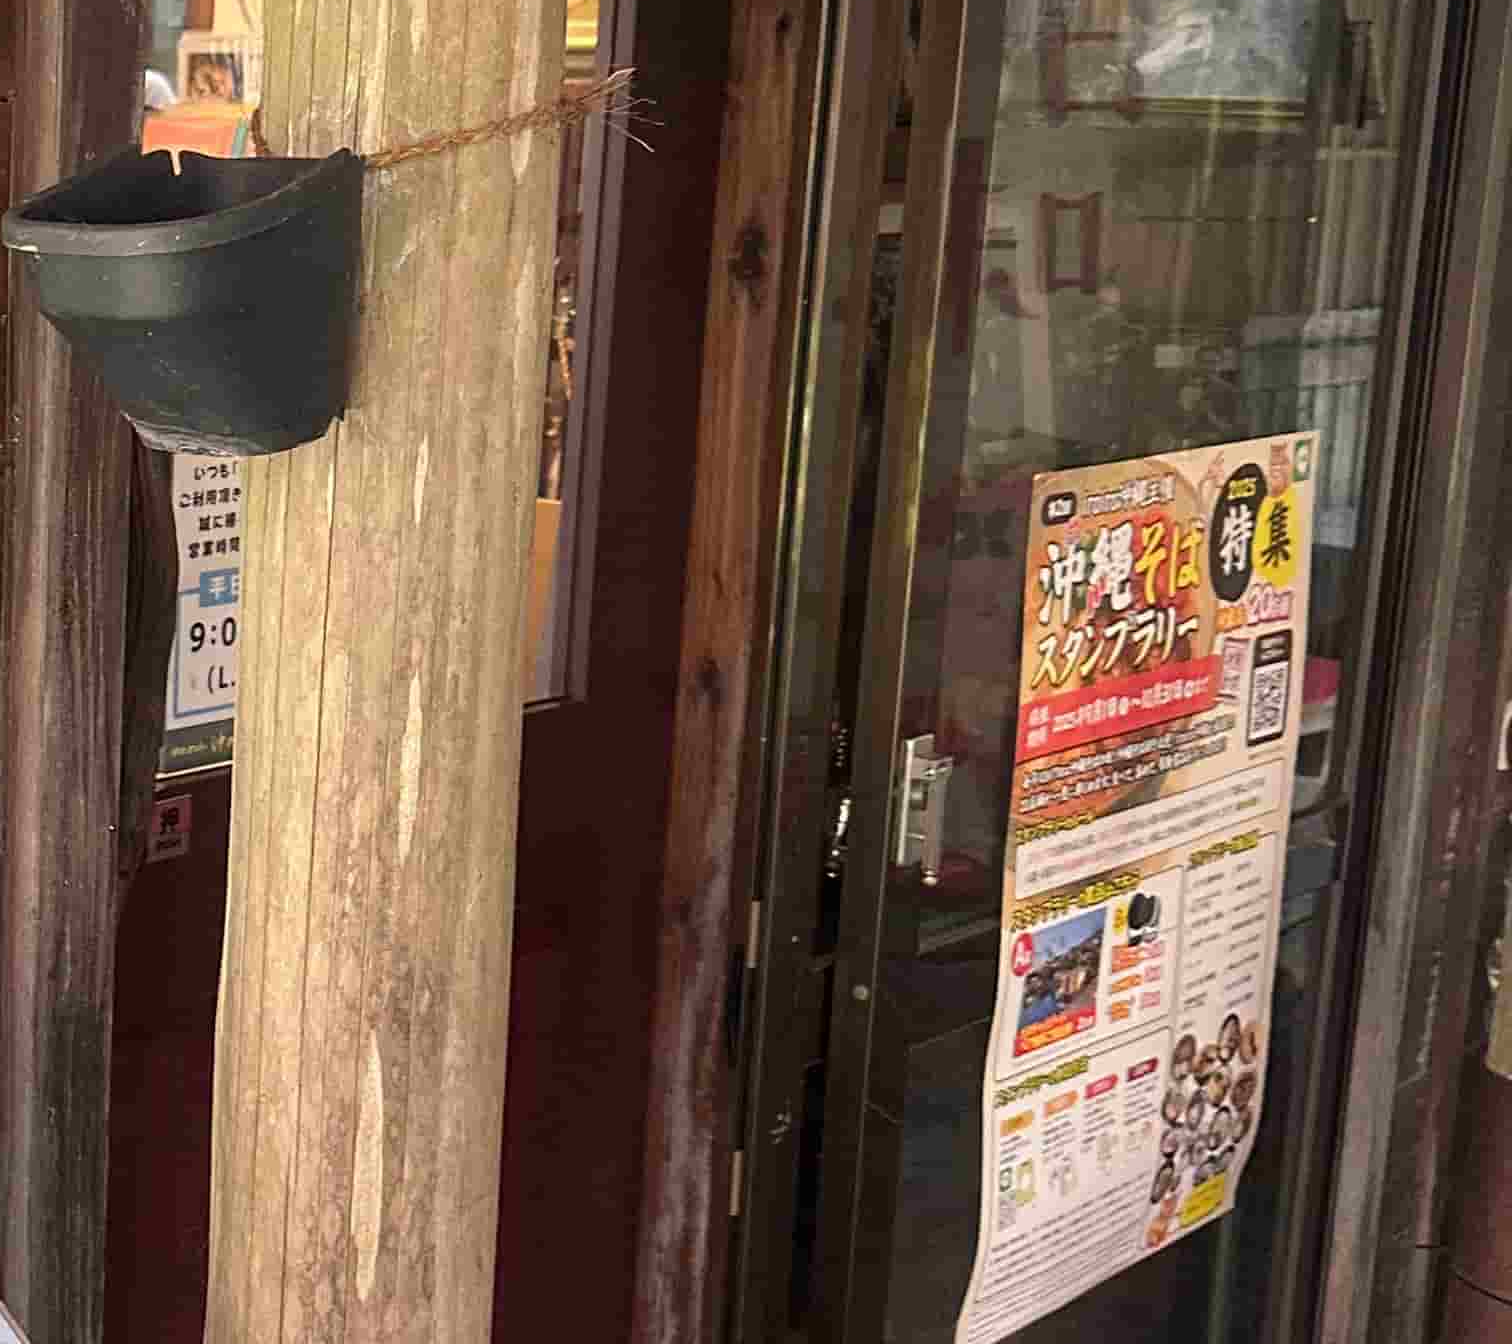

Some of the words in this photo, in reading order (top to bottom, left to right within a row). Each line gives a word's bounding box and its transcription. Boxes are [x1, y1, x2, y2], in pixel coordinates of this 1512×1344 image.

[1038, 519, 1203, 628] 沖縄そば
[1031, 606, 1201, 689] スタンプラリー
